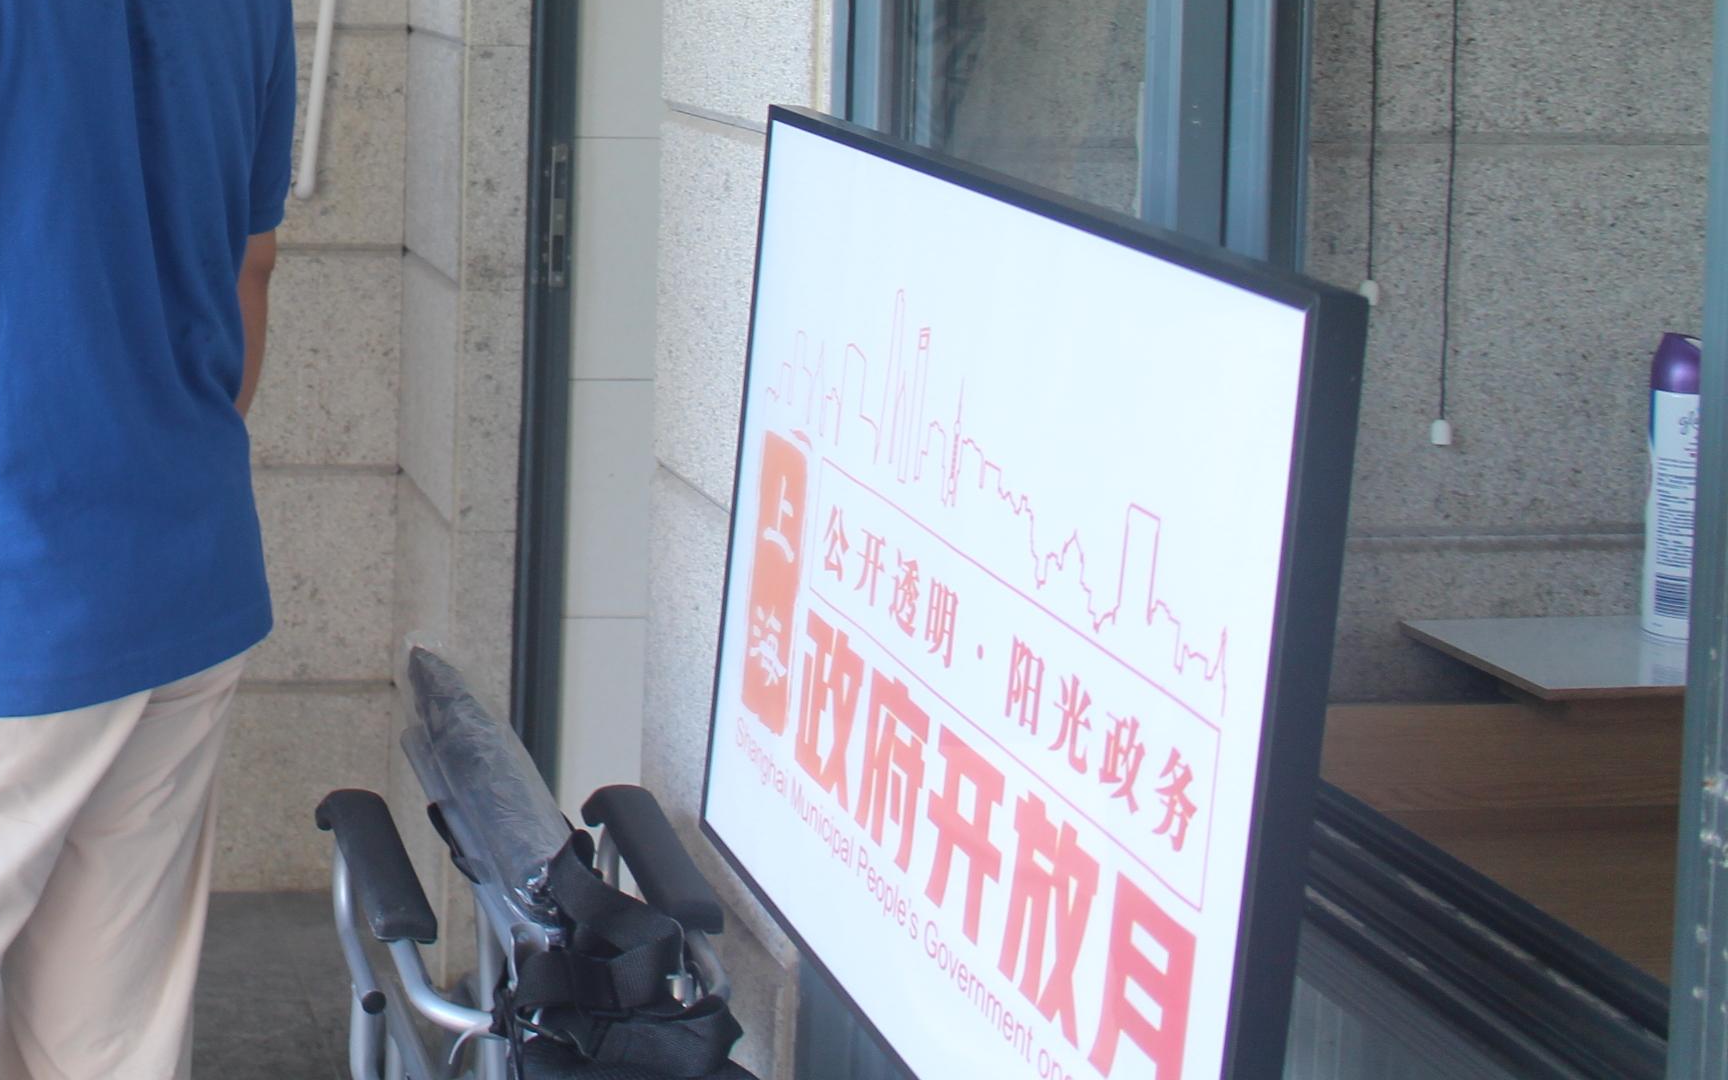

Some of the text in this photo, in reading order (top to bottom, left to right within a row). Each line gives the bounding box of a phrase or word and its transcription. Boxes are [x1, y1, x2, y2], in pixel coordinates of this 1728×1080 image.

[735, 717, 789, 803] Shanghai
[791, 777, 855, 867] Municipal
[856, 845, 919, 940] People's
[923, 919, 1034, 1064] Government
[794, 608, 1198, 1080] 政府开放月
